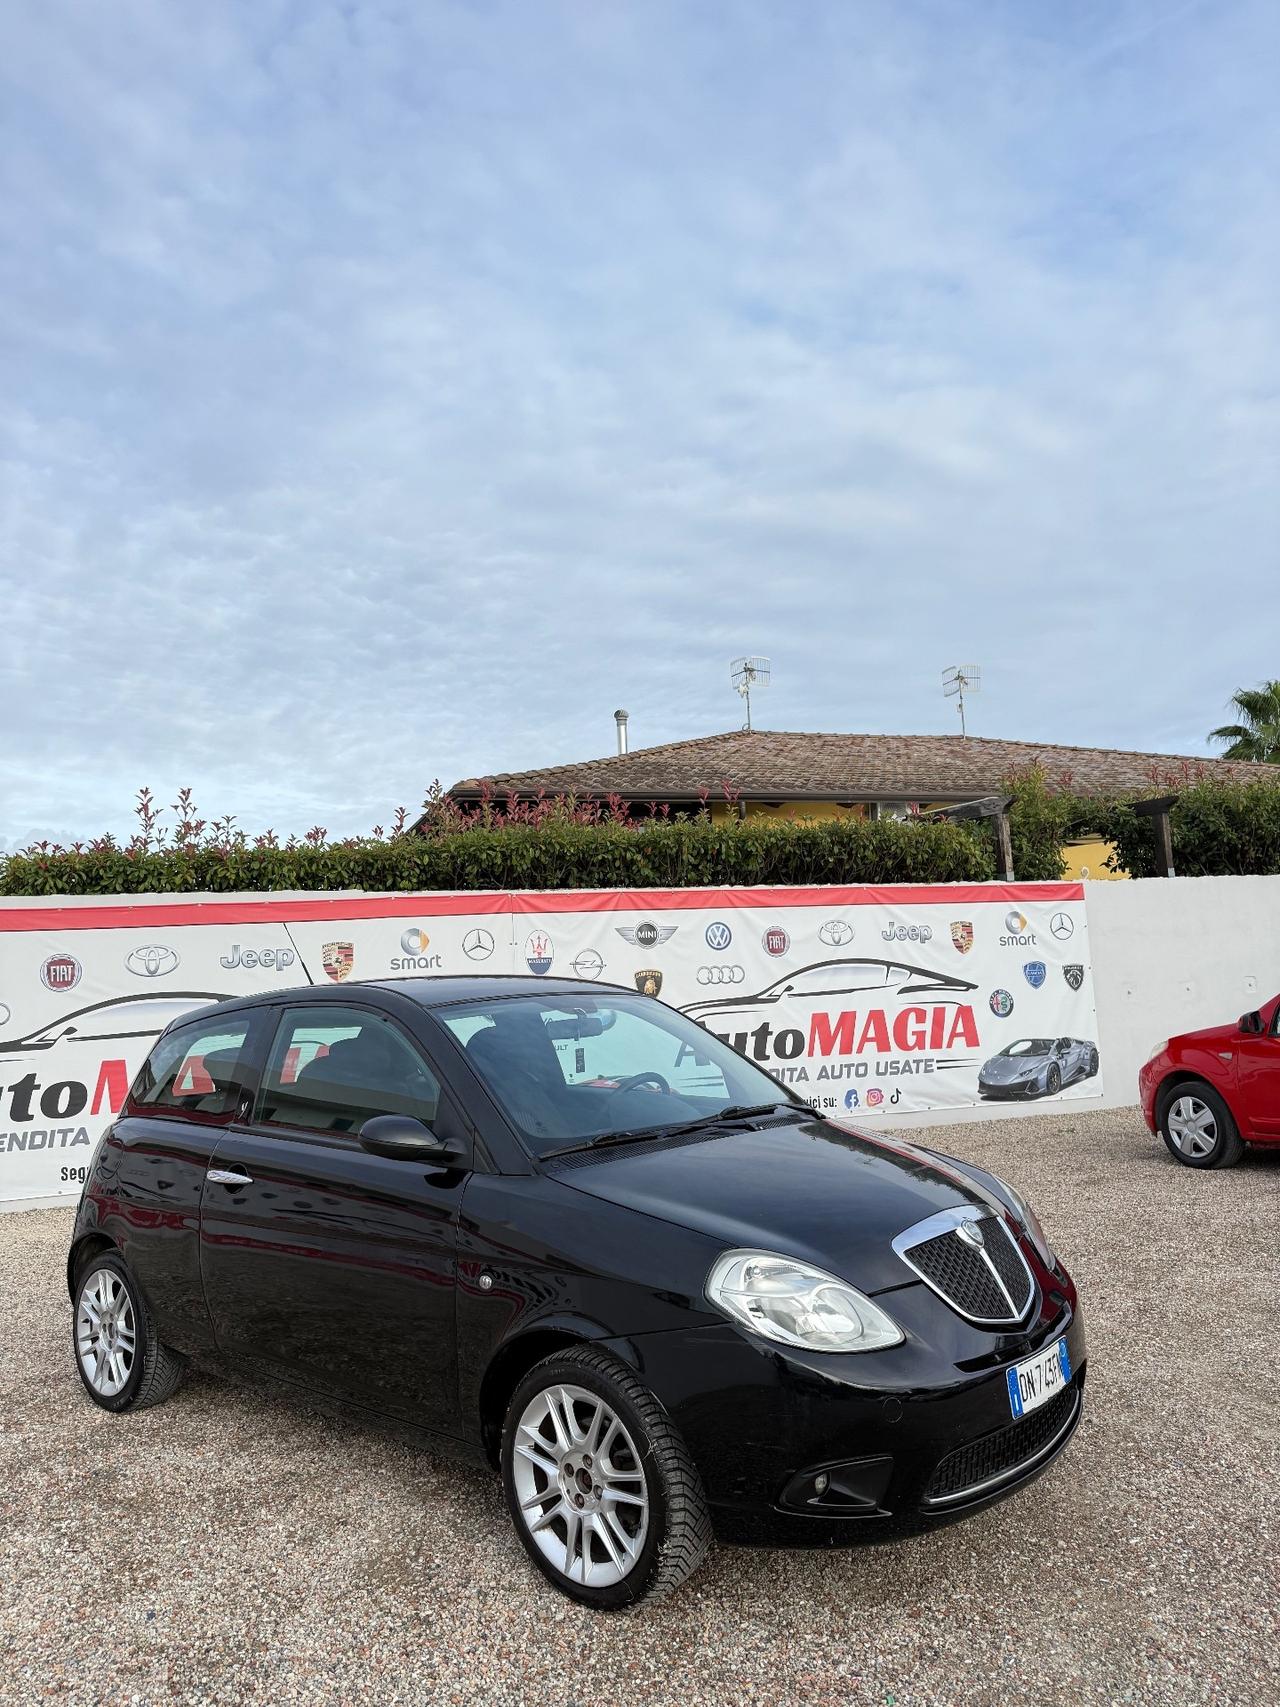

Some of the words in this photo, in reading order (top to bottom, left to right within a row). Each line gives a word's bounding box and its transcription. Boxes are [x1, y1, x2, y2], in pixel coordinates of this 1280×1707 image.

[637, 930, 657, 939] MINI
[881, 921, 933, 944] Jeep
[999, 933, 1038, 947] smart
[768, 934, 786, 950] FIAT
[219, 944, 294, 972] Jeep
[390, 953, 442, 971] smart
[50, 964, 74, 983] FIAT
[816, 1062, 868, 1081] AUTO
[875, 1058, 935, 1077] USATE
